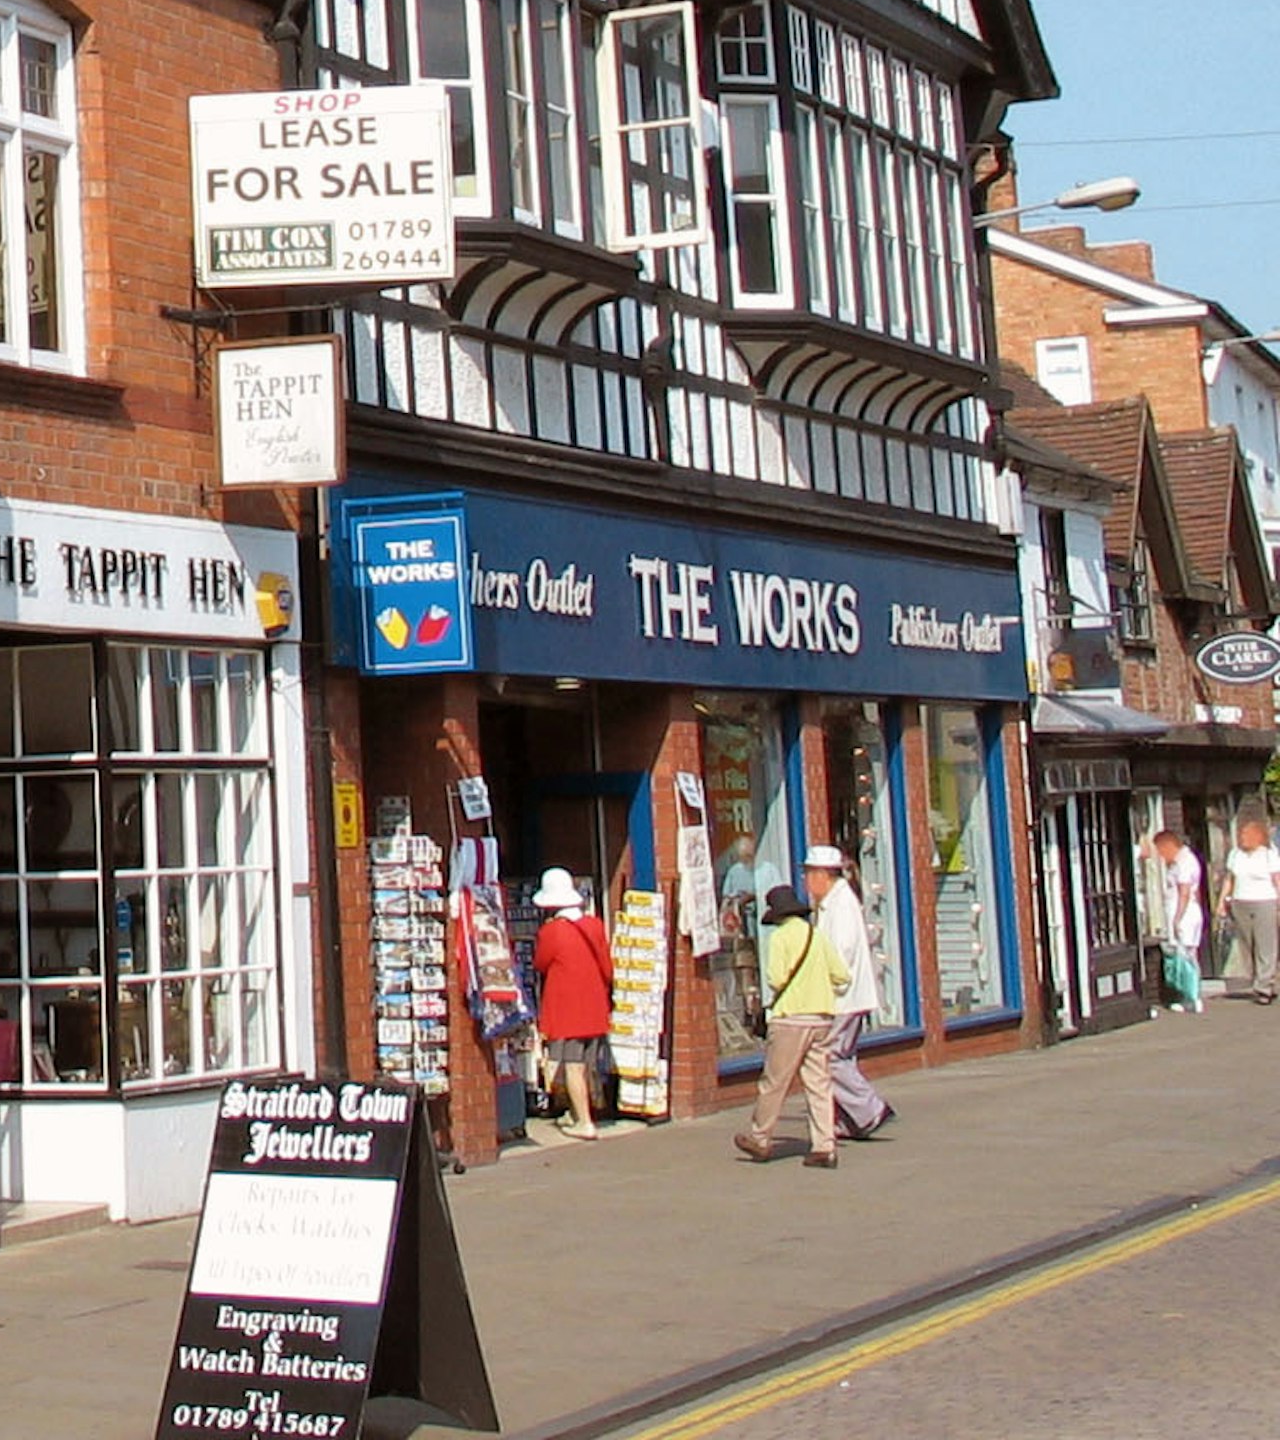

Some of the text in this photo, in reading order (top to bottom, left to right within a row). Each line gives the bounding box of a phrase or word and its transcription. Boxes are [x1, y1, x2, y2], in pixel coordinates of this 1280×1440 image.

[273, 92, 362, 114] SHOP
[258, 116, 378, 150] LEASE
[206, 160, 434, 203] FOR SALE
[214, 225, 328, 254] TIM COX
[348, 219, 433, 243] 01789
[214, 252, 329, 271] ASSOCIATES
[342, 248, 443, 271] 269444
[234, 362, 262, 378] The
[234, 374, 323, 400] TAPPIT
[236, 399, 293, 422] HEN
[385, 539, 434, 560] THE
[59, 542, 167, 599] TAPPIT
[188, 557, 246, 609] HEN
[368, 561, 456, 585] WORKS
[526, 558, 593, 616] Outlet
[630, 553, 860, 655] THE WORKS
[221, 1082, 408, 1123] Stratford Town
[243, 1122, 373, 1164] Jewellers
[217, 1306, 339, 1341] Engraving
[263, 1332, 284, 1353] &
[179, 1347, 368, 1382] Watch Batteries
[246, 1391, 281, 1412] Tel
[173, 1406, 346, 1438] 01789 415687
